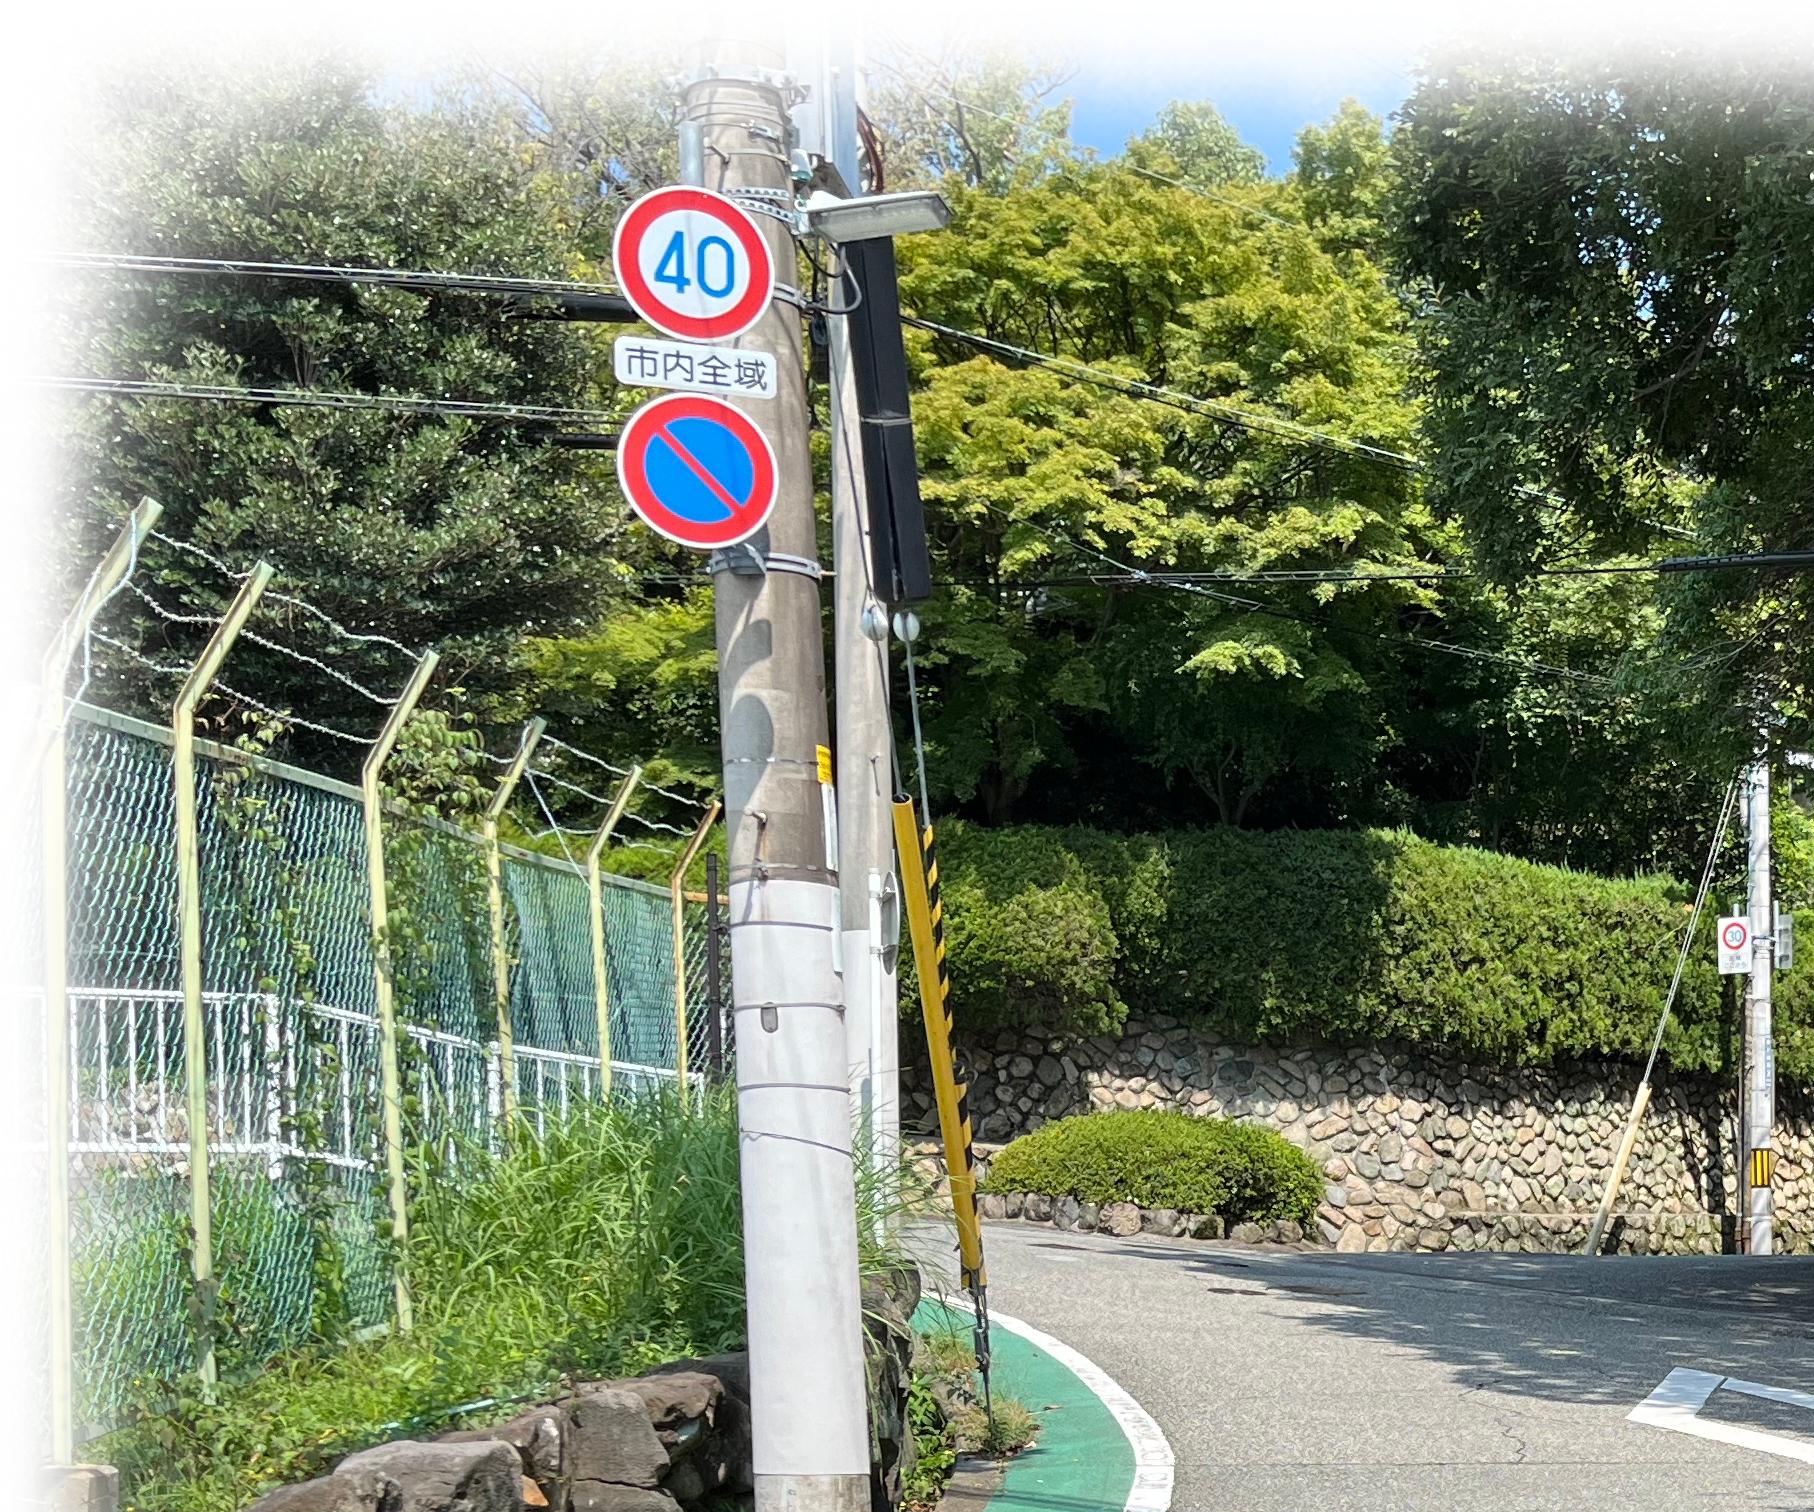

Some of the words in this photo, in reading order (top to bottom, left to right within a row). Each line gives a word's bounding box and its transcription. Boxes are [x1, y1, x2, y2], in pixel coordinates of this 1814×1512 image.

[653, 230, 736, 299] 40
[624, 345, 769, 392] 市内全域
[1728, 930, 1742, 942] 30
